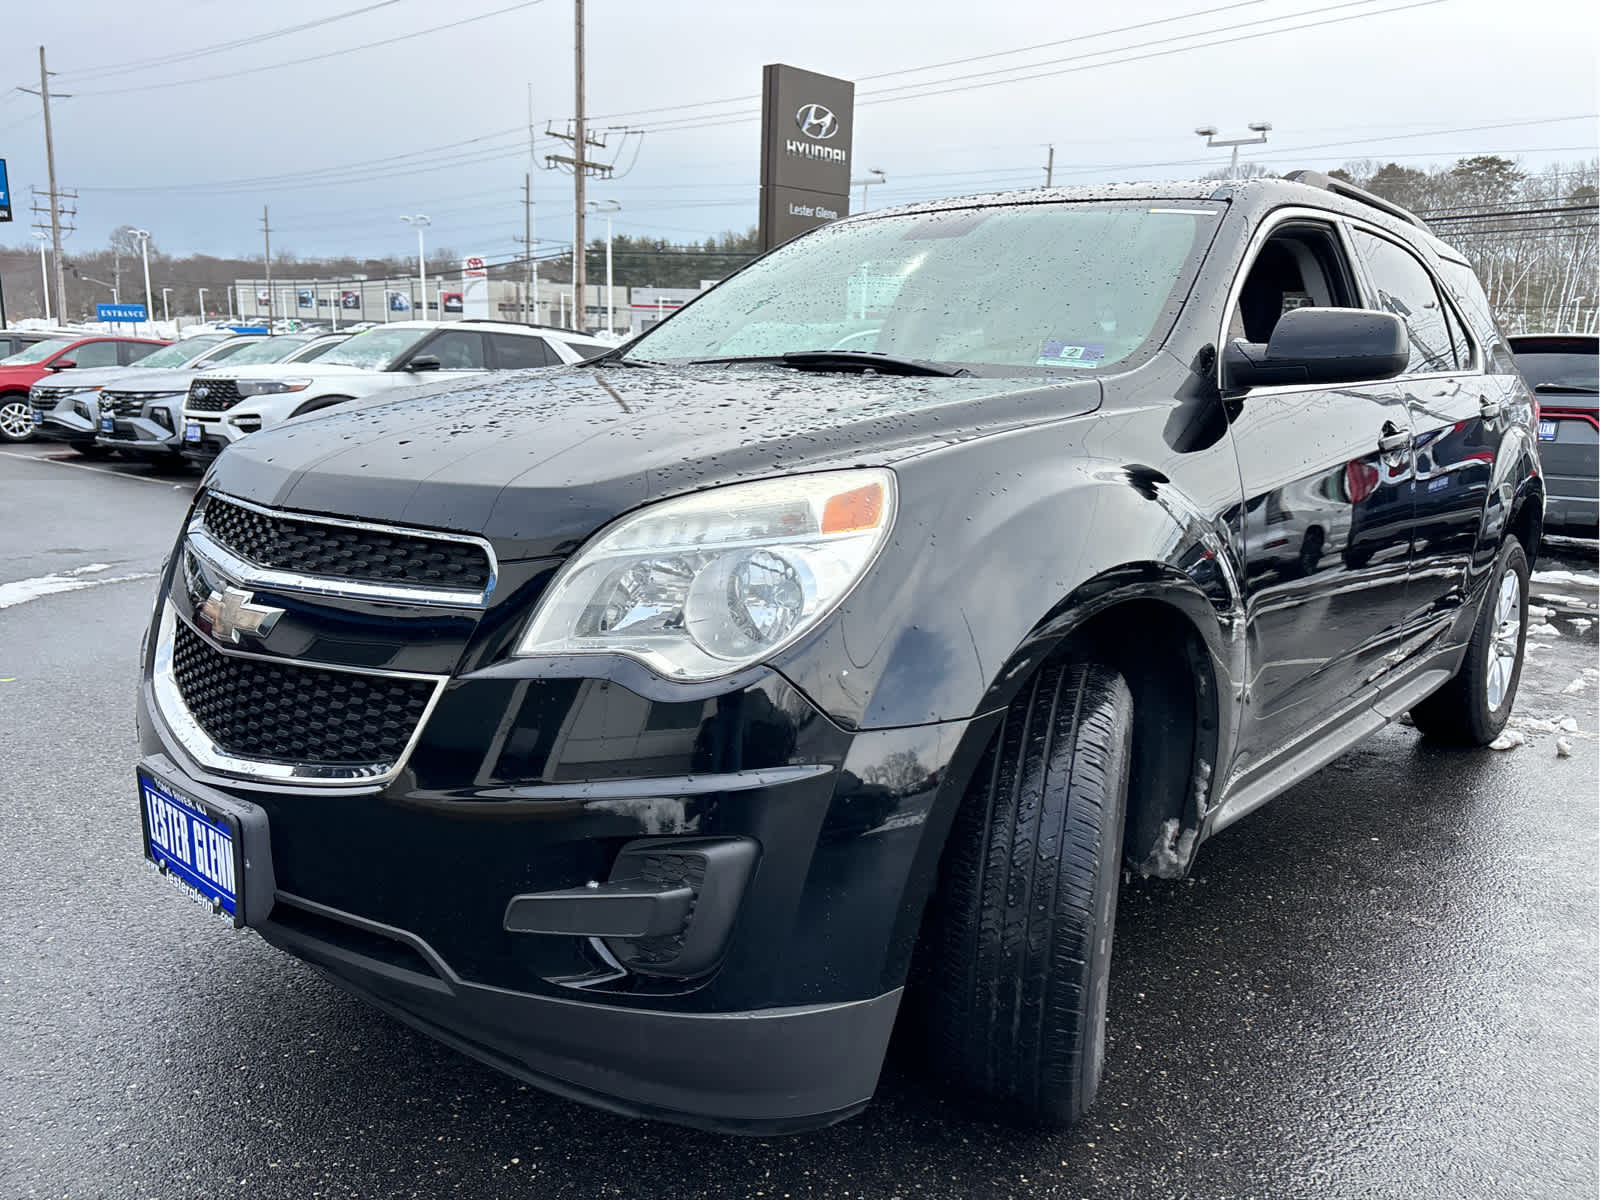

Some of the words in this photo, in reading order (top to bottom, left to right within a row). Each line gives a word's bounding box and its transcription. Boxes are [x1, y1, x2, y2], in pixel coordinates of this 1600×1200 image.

[786, 139, 846, 161] HYUNDAI
[789, 202, 814, 217] Lester
[815, 205, 839, 220] Glenn
[100, 309, 145, 318] ENTRANCE
[195, 801, 208, 816] NJ
[144, 790, 192, 866] LESTER
[192, 818, 237, 896] GLENN
